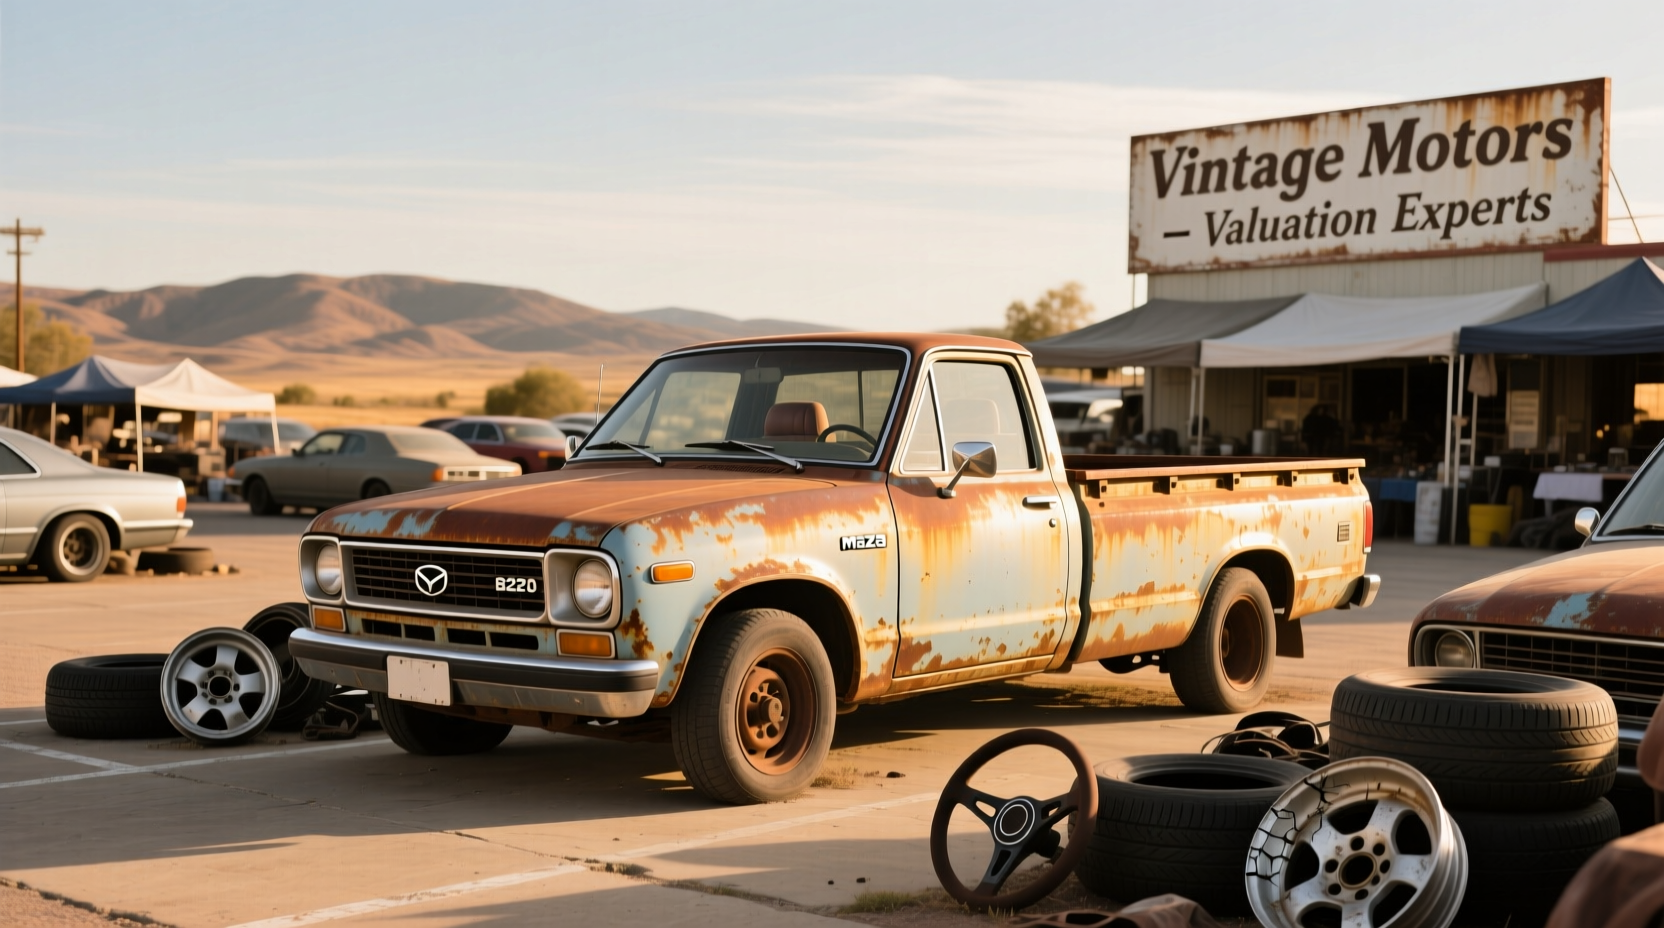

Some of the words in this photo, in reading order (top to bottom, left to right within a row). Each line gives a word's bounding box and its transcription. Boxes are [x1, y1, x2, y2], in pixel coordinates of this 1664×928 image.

[1149, 141, 1345, 203] Vintage
[1358, 117, 1574, 178] Motors
[1205, 201, 1377, 247] Valuation
[1391, 187, 1552, 240] Experts
[495, 576, 537, 593] B220
